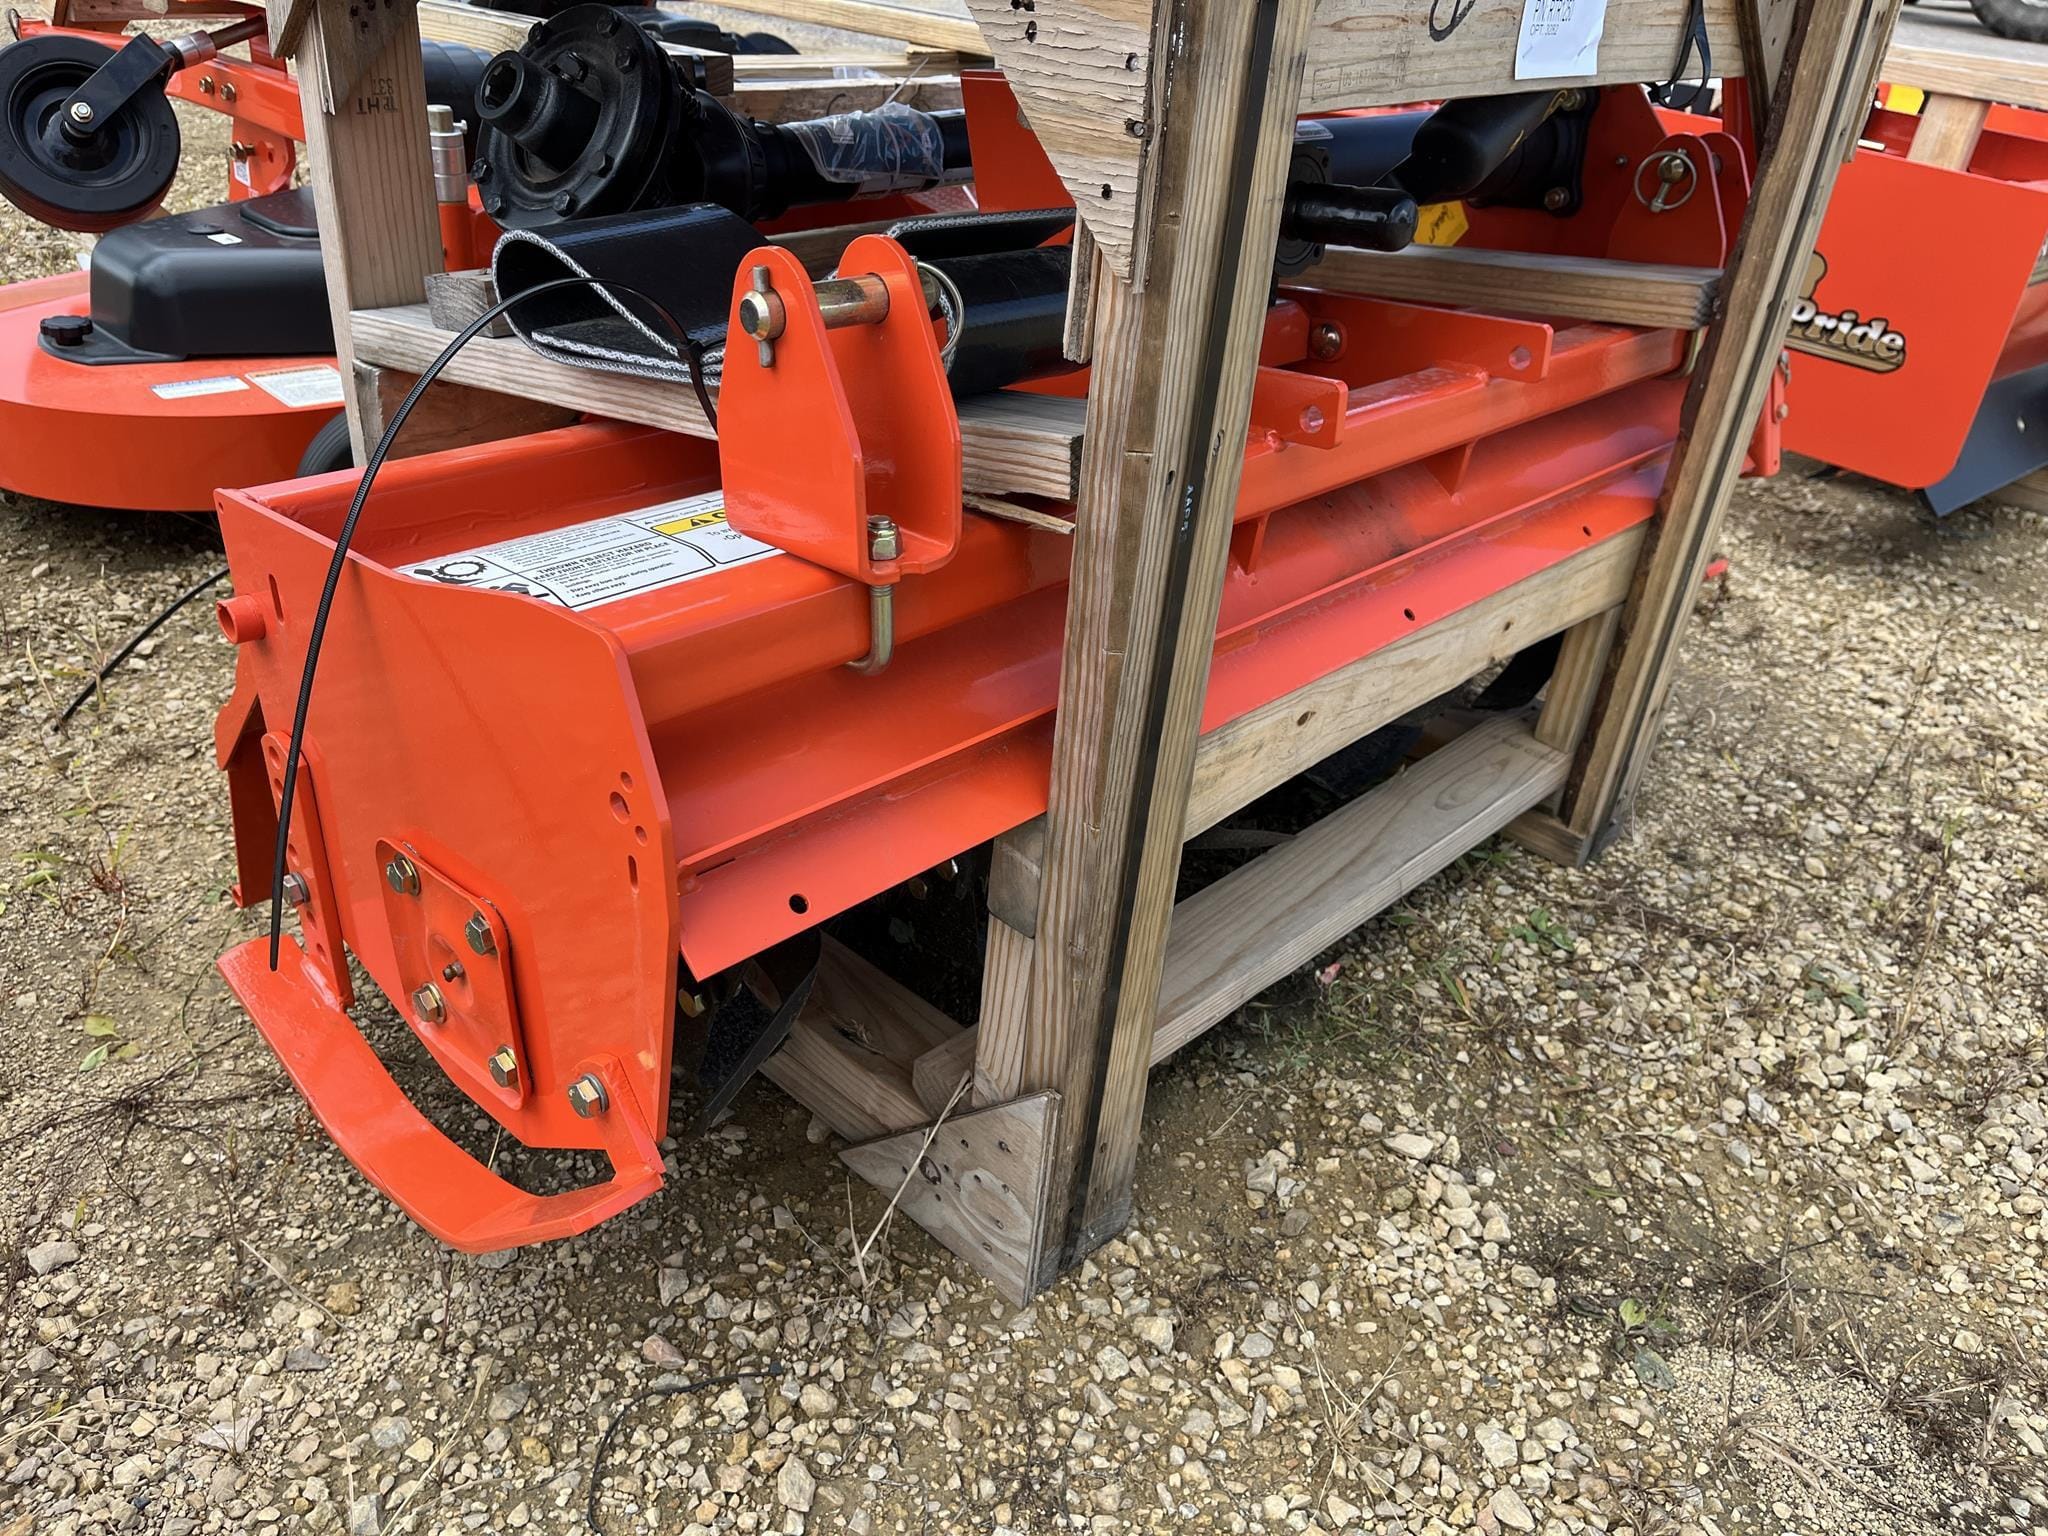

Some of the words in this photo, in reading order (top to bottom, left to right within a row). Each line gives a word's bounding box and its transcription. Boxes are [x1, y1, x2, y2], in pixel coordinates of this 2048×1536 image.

[1790, 297, 1906, 361] Pride
[532, 571, 557, 581] KEEP
[557, 564, 586, 575] FRONT
[586, 551, 634, 567] DEFLECTOR
[644, 541, 670, 551] PLACE
[536, 560, 580, 574] THROWN
[579, 551, 615, 563] OBJECT
[615, 541, 653, 553] HAZARD
